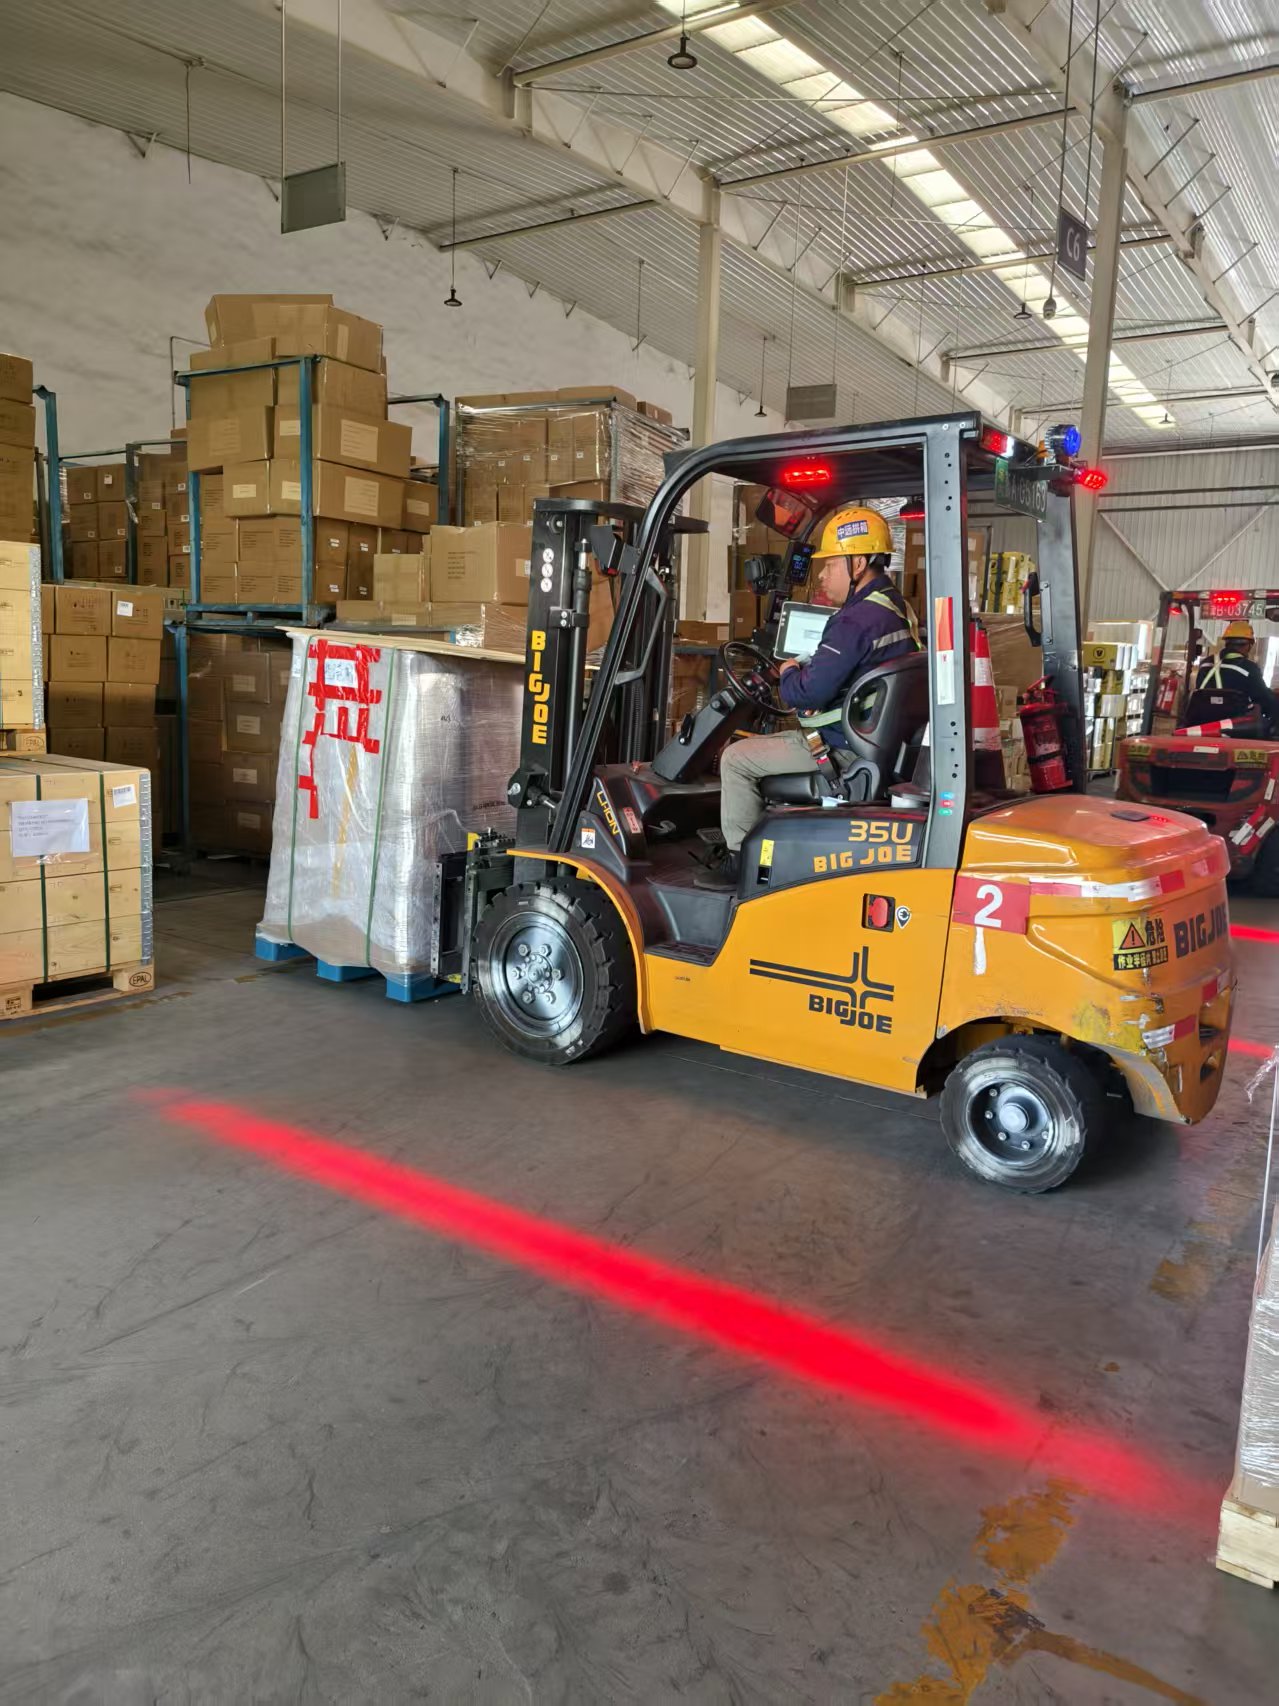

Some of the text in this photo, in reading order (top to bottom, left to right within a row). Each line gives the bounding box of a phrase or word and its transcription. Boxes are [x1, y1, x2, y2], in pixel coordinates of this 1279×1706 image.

[1066, 227, 1080, 262] C6
[848, 820, 913, 844] 35U
[813, 844, 912, 873] BIG JOE
[974, 884, 1004, 929] 2
[132, 975, 149, 985] EPAL
